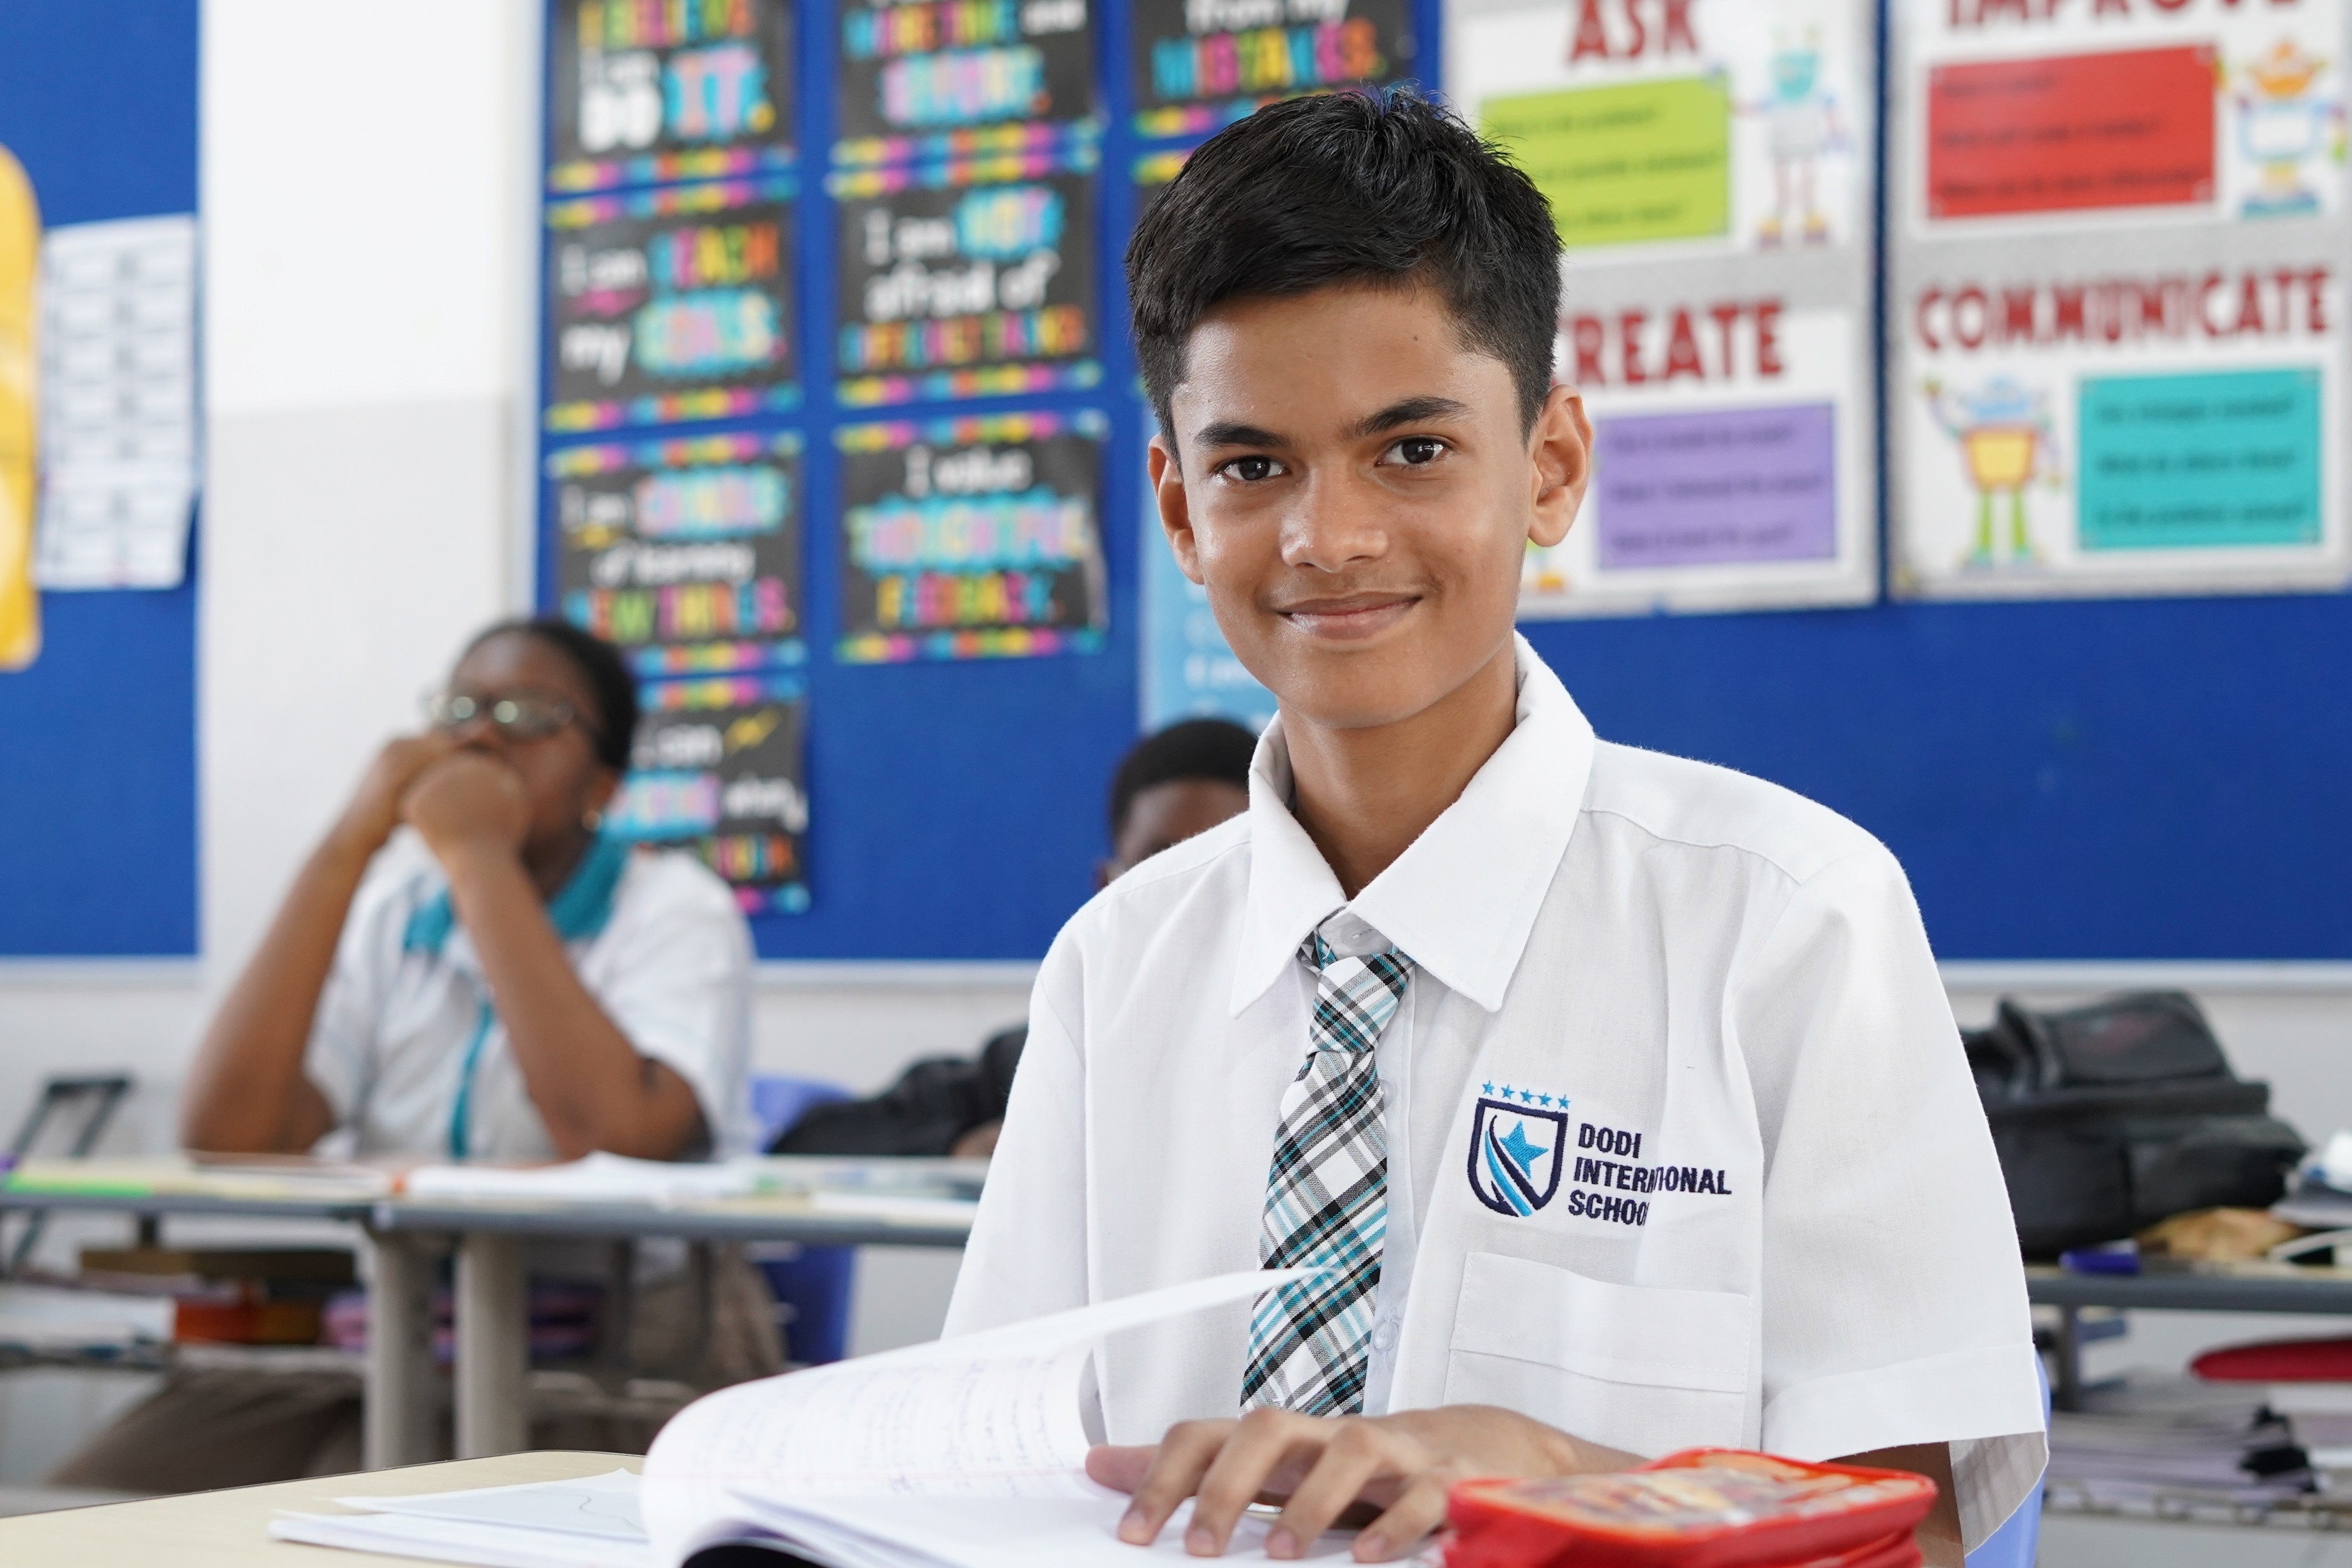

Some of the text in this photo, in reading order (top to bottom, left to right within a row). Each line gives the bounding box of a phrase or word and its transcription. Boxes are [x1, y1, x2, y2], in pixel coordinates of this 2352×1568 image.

[1568, 0, 1698, 65] ASK
[866, 250, 1059, 320] afraid of
[1917, 266, 2327, 351] COMMUNICATE
[1554, 296, 1784, 386] REATE
[1578, 1123, 1642, 1159] DODI
